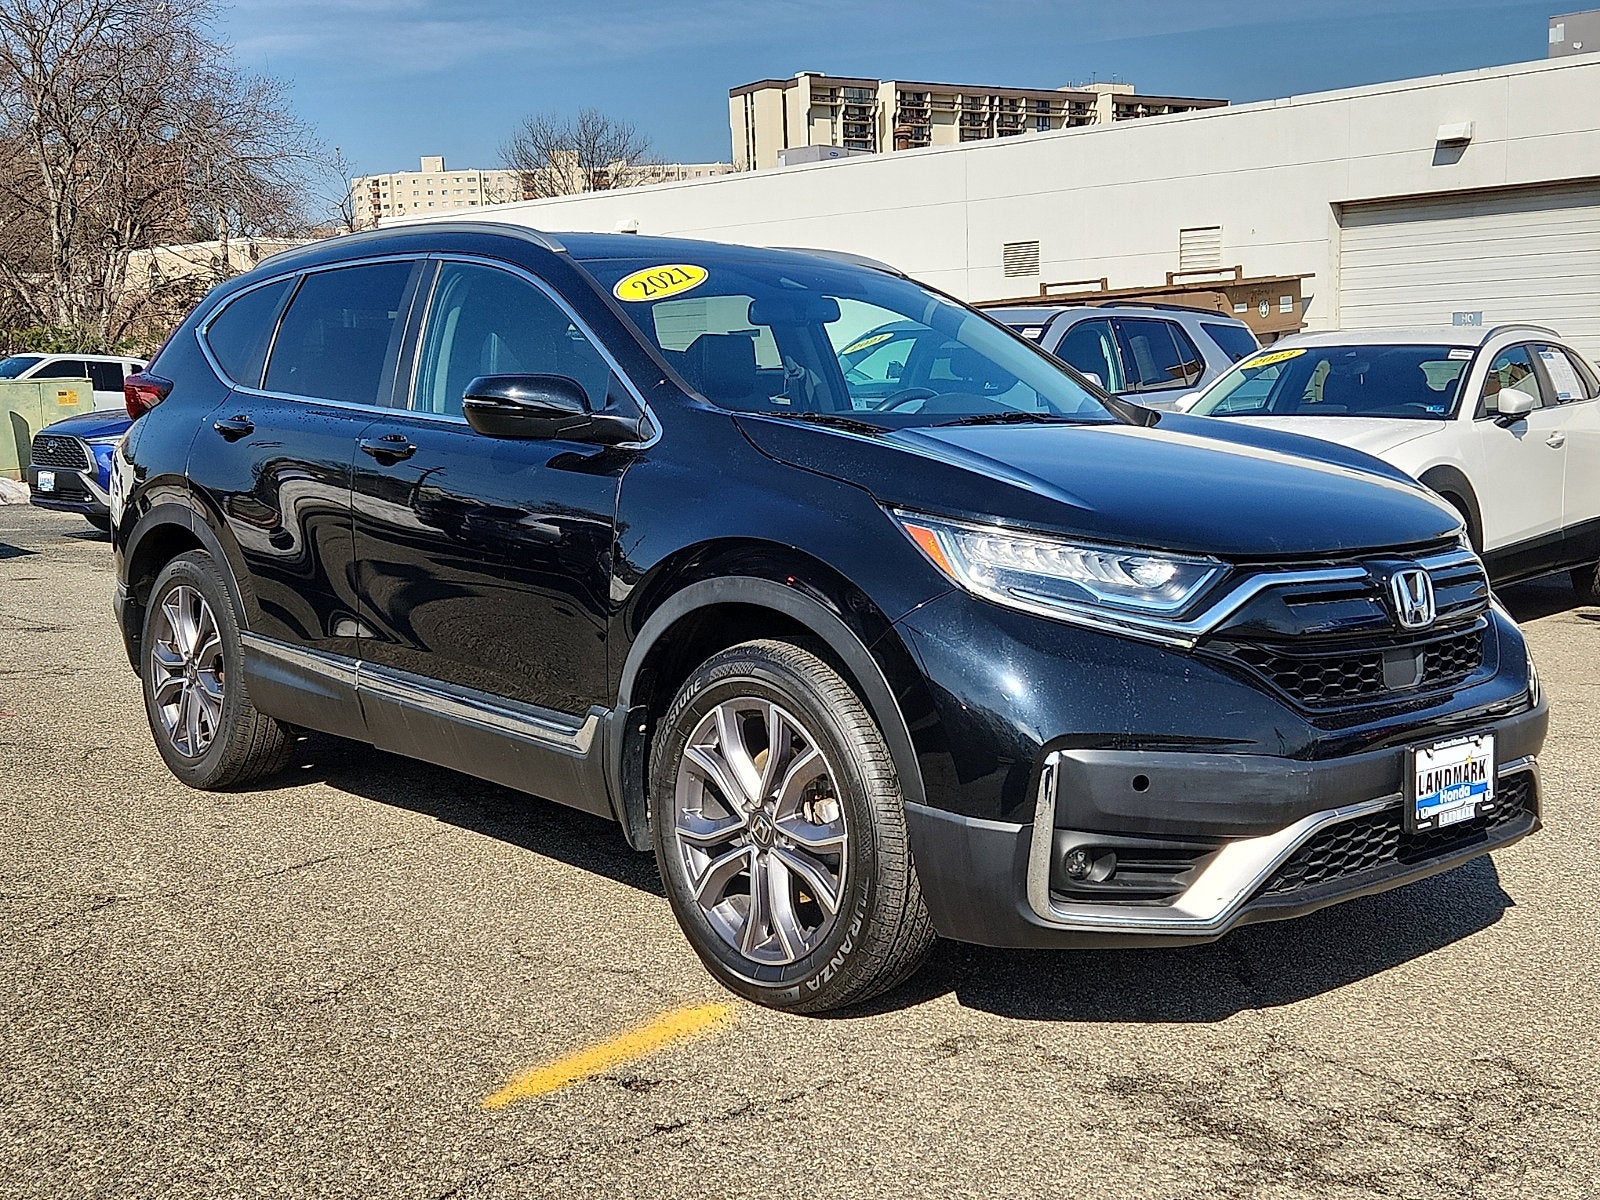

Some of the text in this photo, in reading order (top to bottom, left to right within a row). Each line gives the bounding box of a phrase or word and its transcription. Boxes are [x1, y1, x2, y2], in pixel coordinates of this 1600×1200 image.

[631, 267, 696, 297] 2021
[652, 676, 702, 772] IDGESTONE
[1418, 758, 1486, 796] LANDMARK
[1440, 784, 1472, 805] Honda
[805, 876, 870, 991] TURANZA
